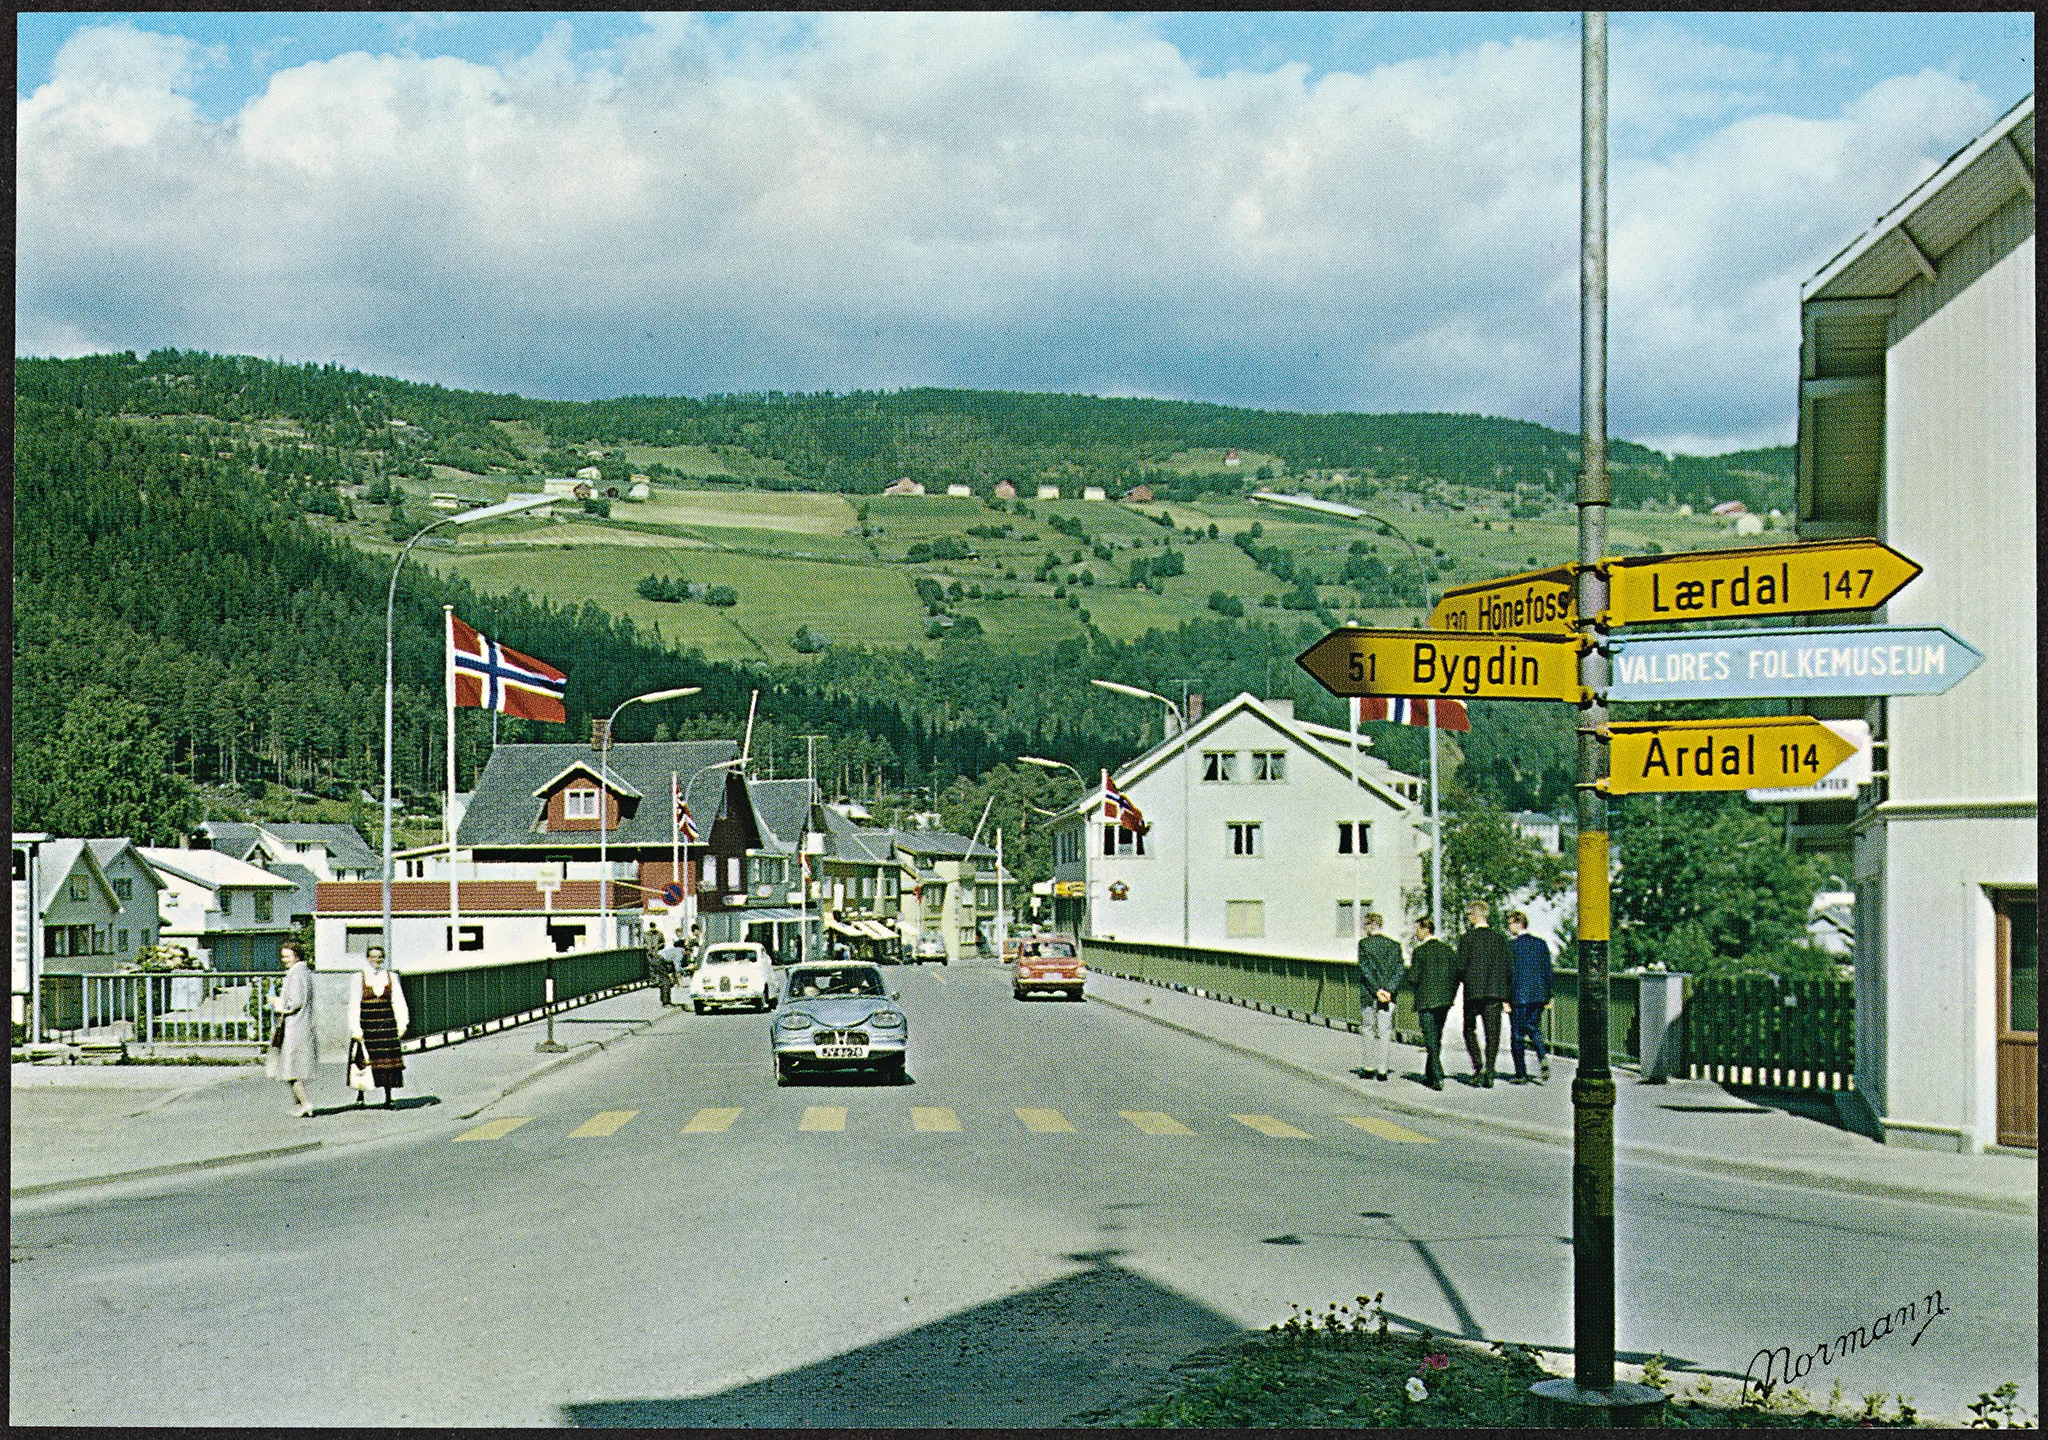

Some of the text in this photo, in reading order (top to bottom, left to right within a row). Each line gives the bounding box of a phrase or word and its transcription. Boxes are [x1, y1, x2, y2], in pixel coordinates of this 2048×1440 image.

[1478, 586, 1570, 631] Hönefoss
[1652, 562, 1874, 612] Lærdal 147
[1349, 643, 1539, 693] 51 Bygdin
[1618, 645, 1945, 685] VALDRES FOLKEMUSEUM
[1780, 743, 1820, 774] 114
